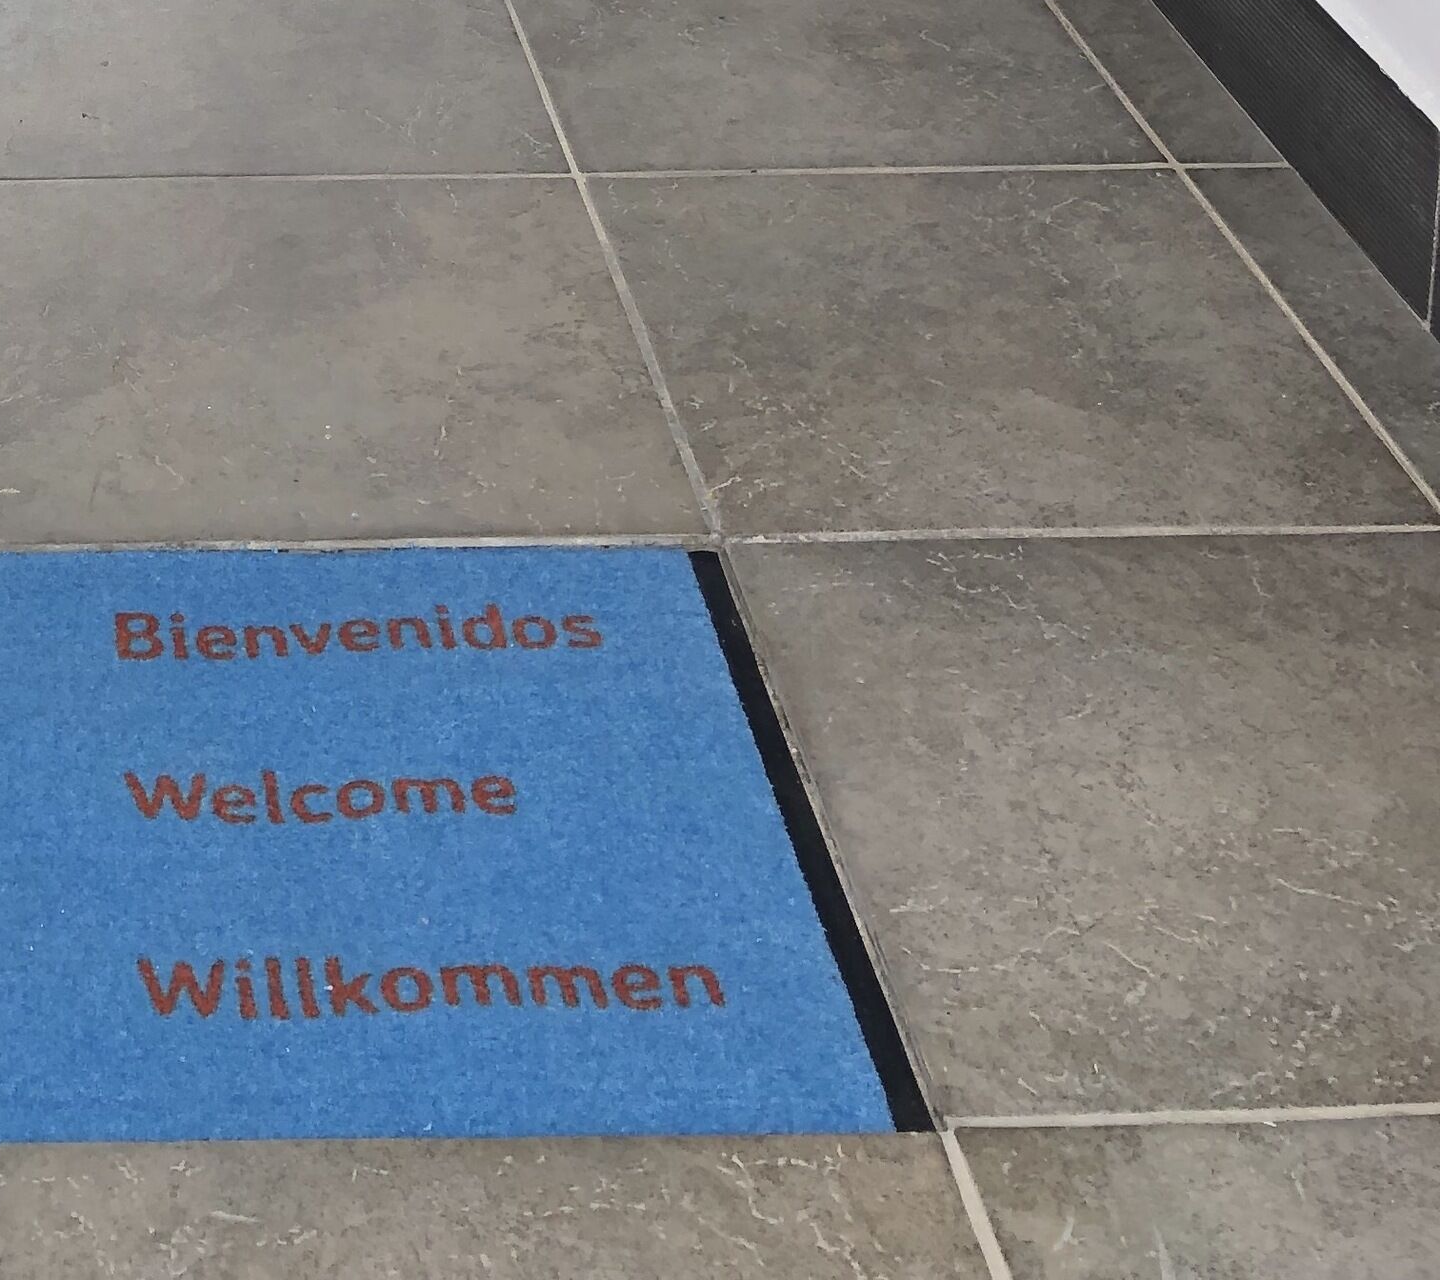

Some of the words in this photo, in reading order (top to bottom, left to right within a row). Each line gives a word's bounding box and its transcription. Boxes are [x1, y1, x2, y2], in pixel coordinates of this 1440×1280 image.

[114, 603, 604, 661] Bienvenidos
[123, 770, 517, 825] Welcome
[137, 955, 726, 1021] Willkommen
